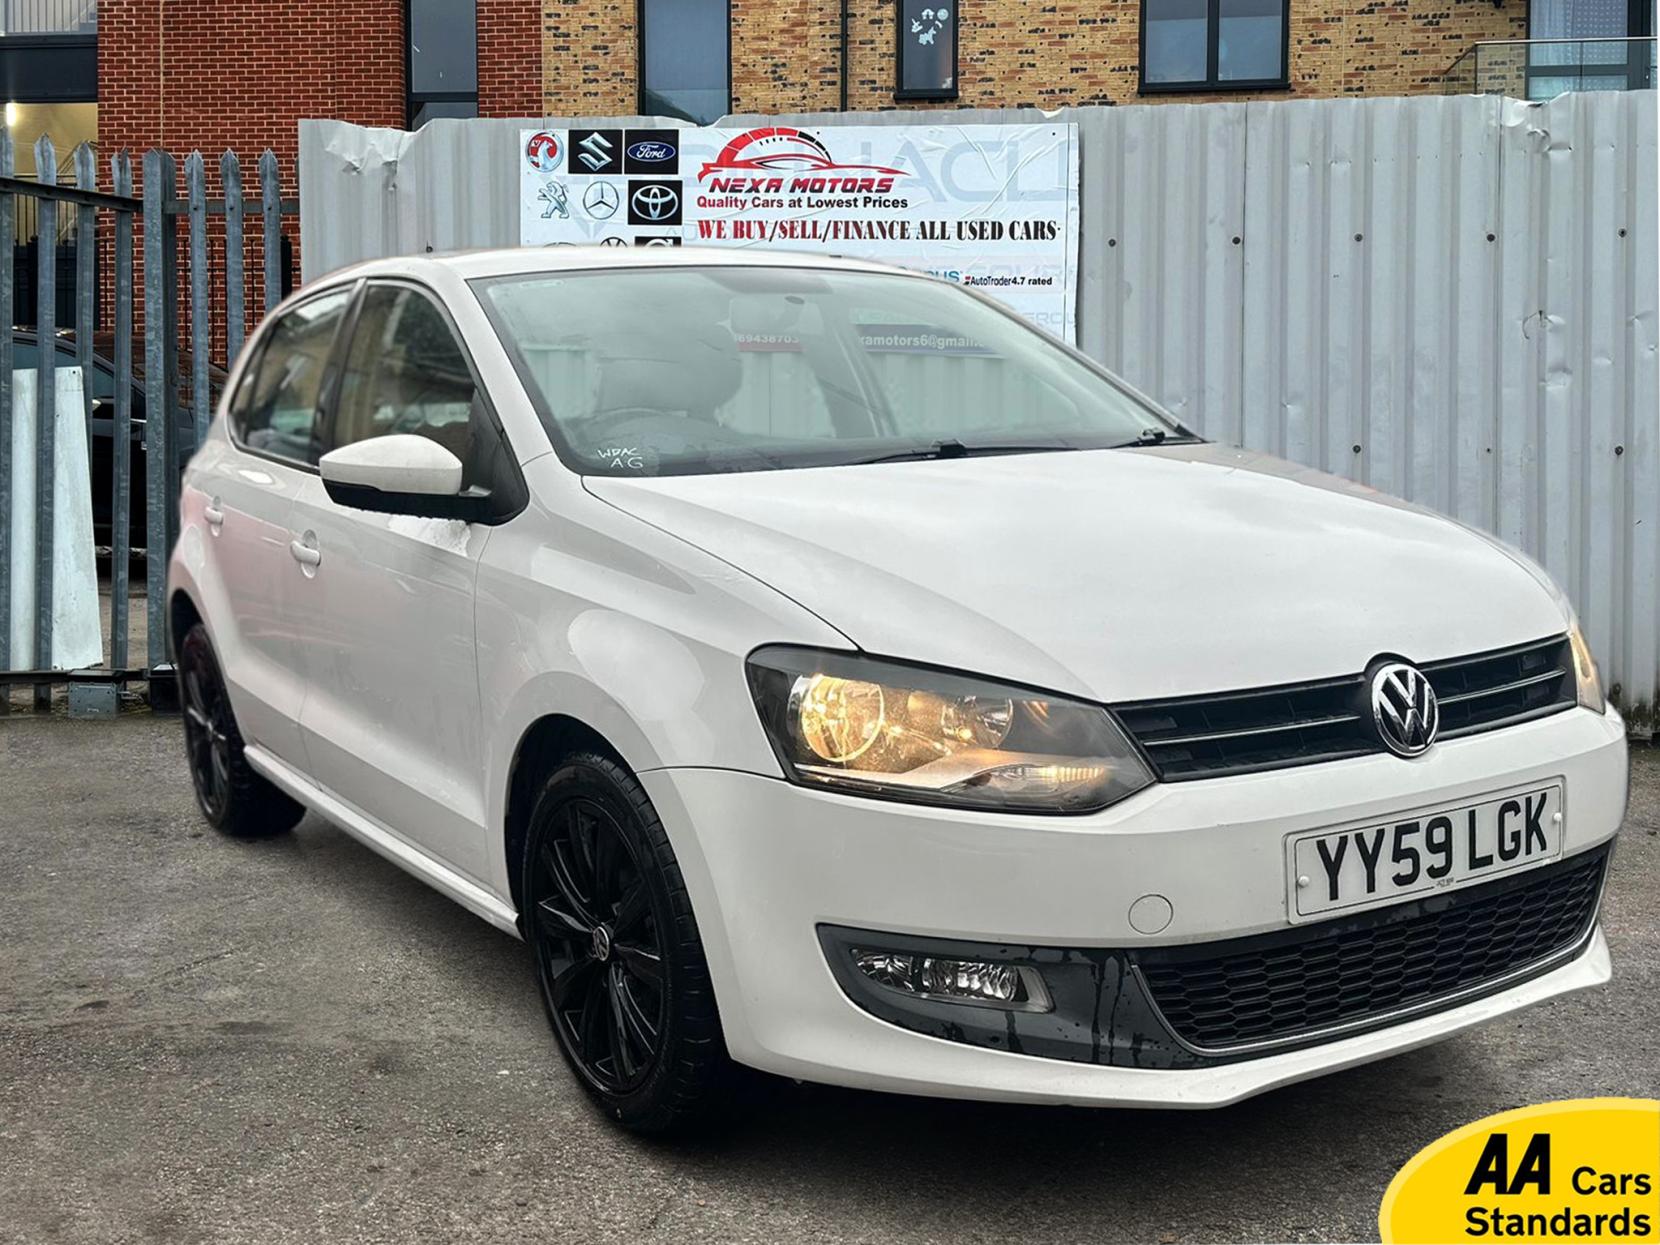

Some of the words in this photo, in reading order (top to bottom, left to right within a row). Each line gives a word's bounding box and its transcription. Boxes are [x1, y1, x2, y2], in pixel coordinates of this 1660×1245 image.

[637, 144, 667, 158] Ford
[709, 178, 784, 193] NEXA
[789, 178, 894, 193] MOTORS
[697, 196, 747, 210] Quality
[752, 196, 784, 208] Cars
[788, 197, 803, 208] at
[807, 196, 858, 208] Lowest
[863, 196, 908, 208] Prices
[697, 220, 727, 239] WE
[916, 221, 951, 240] ALL
[956, 221, 1004, 240] USED
[1009, 220, 1057, 240] CARS
[1028, 276, 1052, 285] rated
[1316, 815, 1453, 901] YY59
[1468, 792, 1548, 870] LGK
